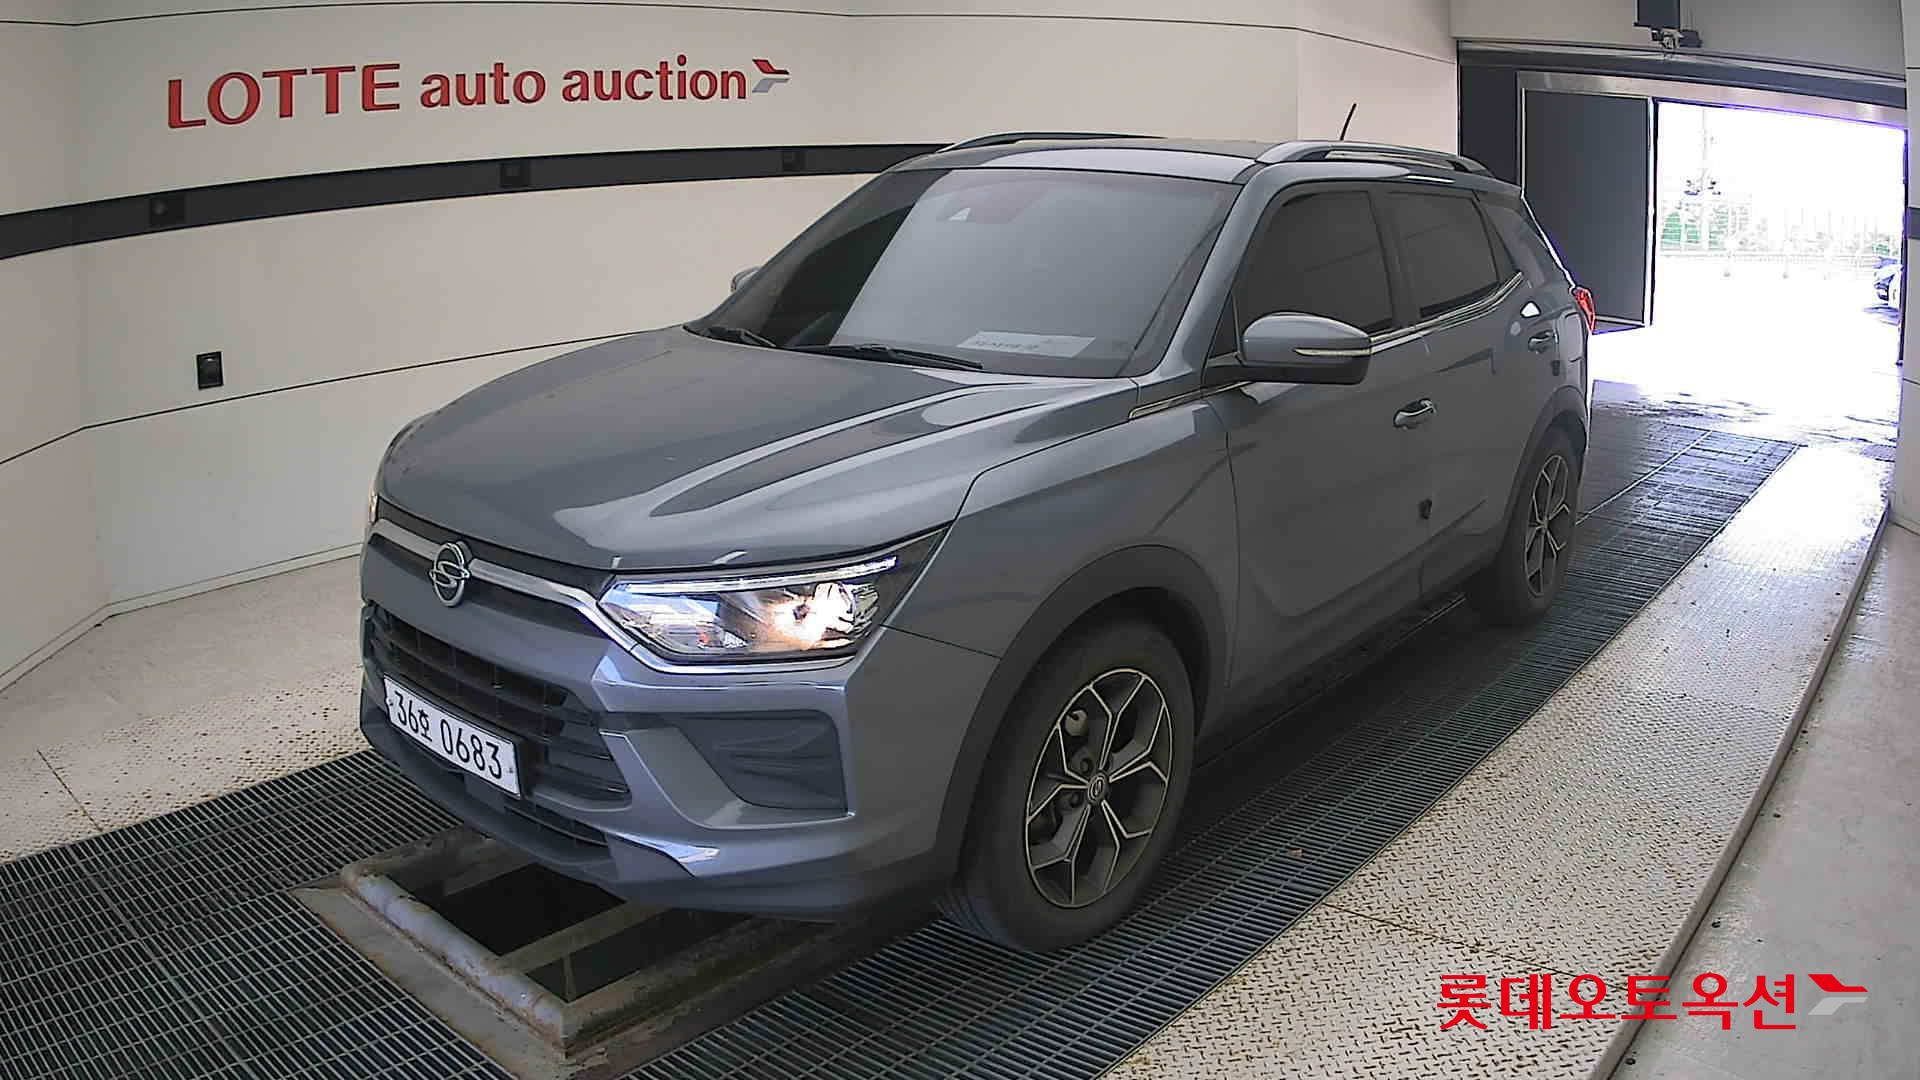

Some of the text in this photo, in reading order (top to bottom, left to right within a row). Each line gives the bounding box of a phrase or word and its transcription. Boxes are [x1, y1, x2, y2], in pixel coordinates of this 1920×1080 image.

[168, 54, 747, 129] LOTTE auto auction
[440, 719, 502, 779] 0683
